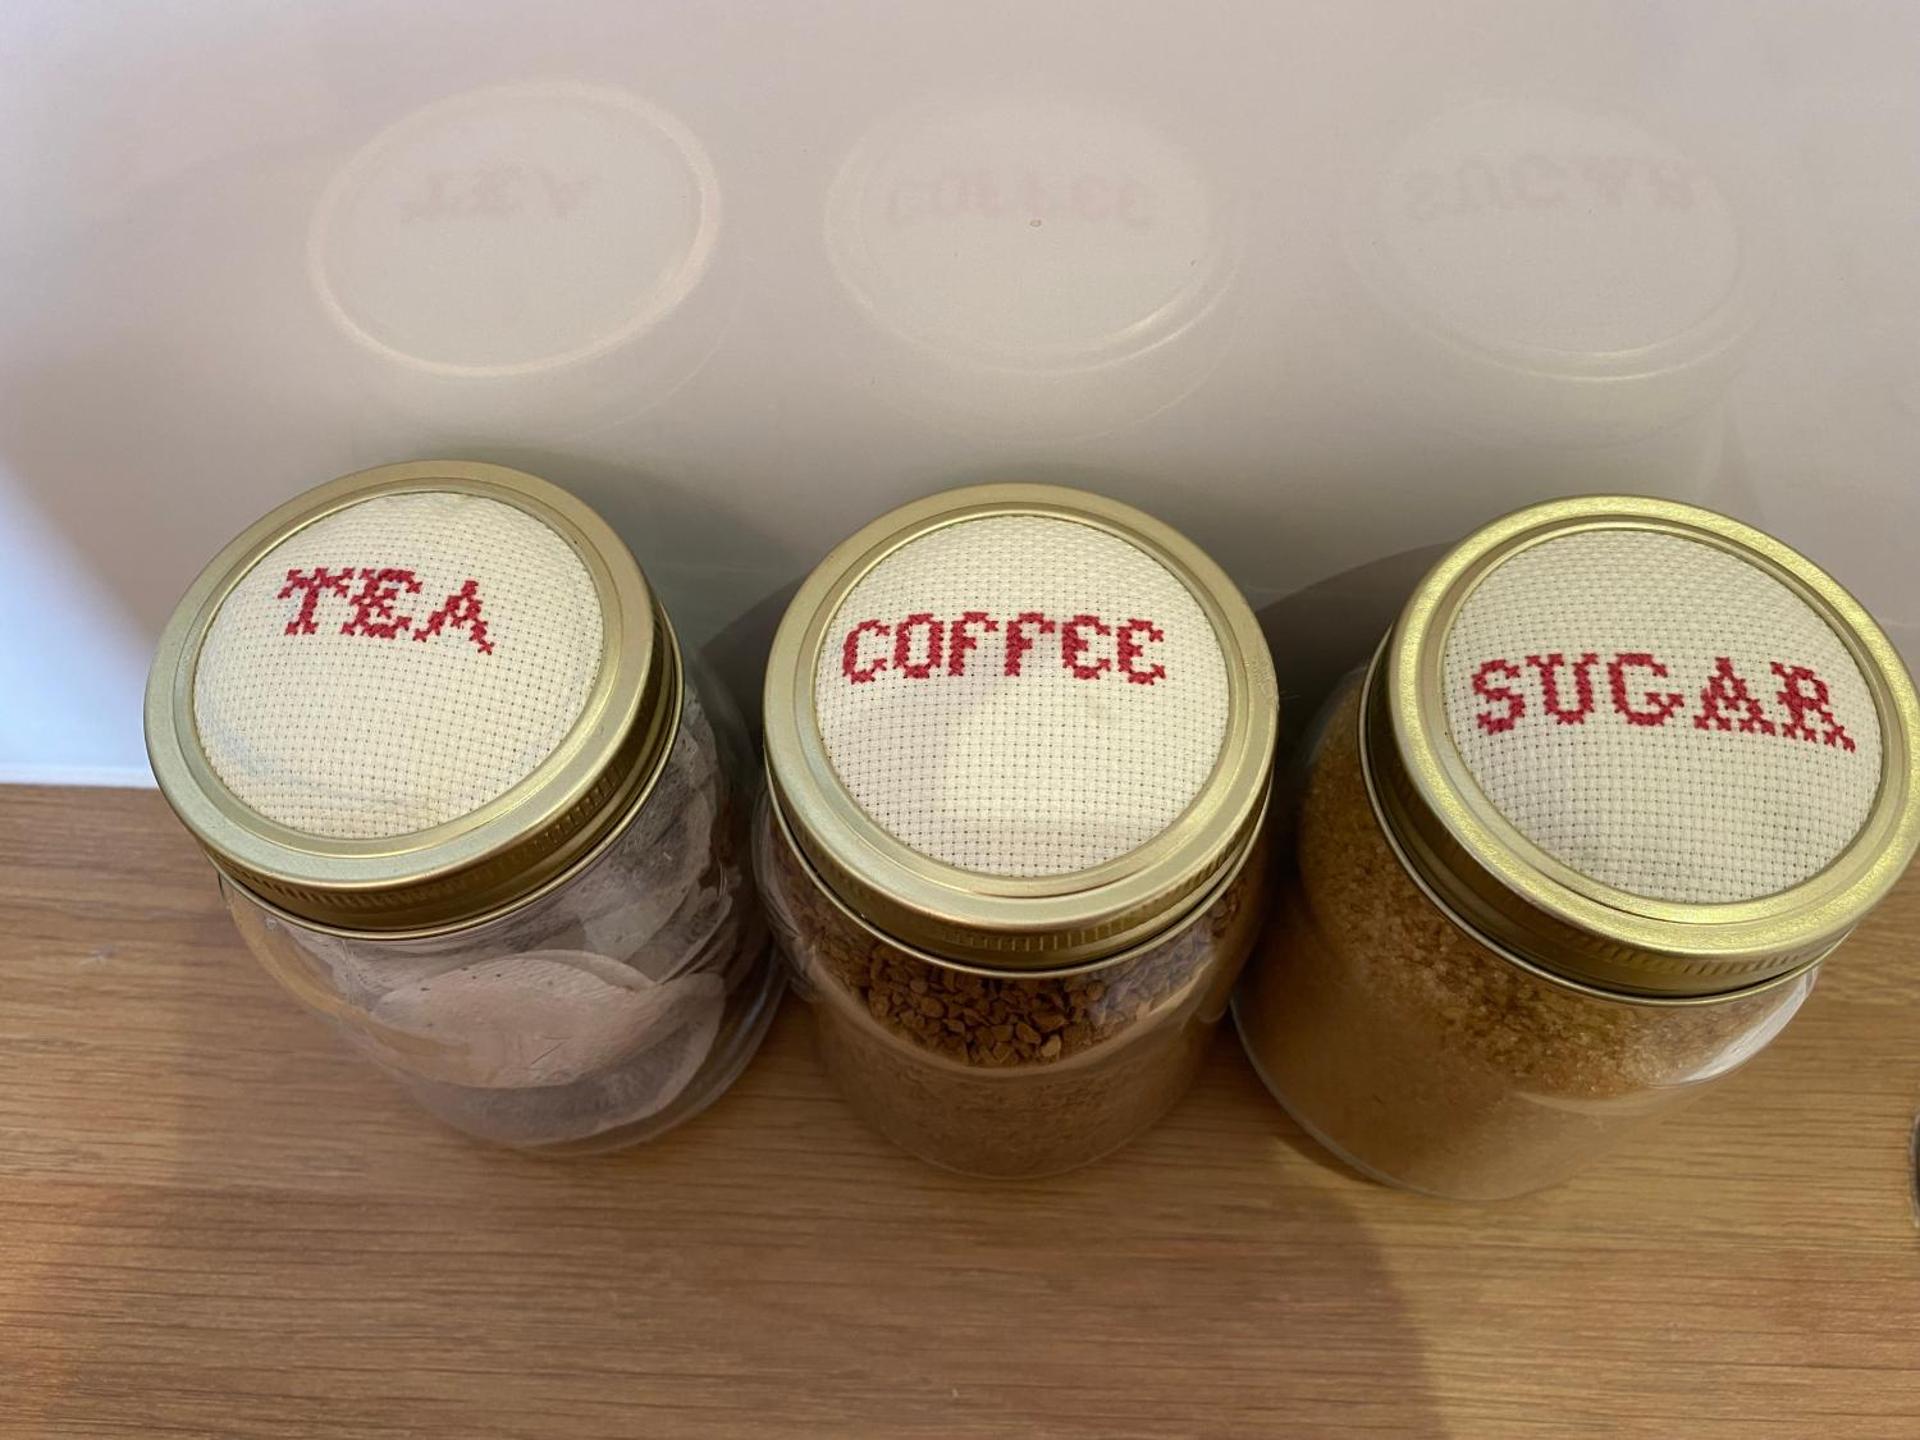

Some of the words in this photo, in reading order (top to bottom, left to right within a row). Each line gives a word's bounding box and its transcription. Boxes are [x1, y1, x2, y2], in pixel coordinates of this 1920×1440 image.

[278, 567, 494, 655] TEA
[842, 611, 1166, 685] COFFEE
[1472, 653, 1856, 752] SUGAR
